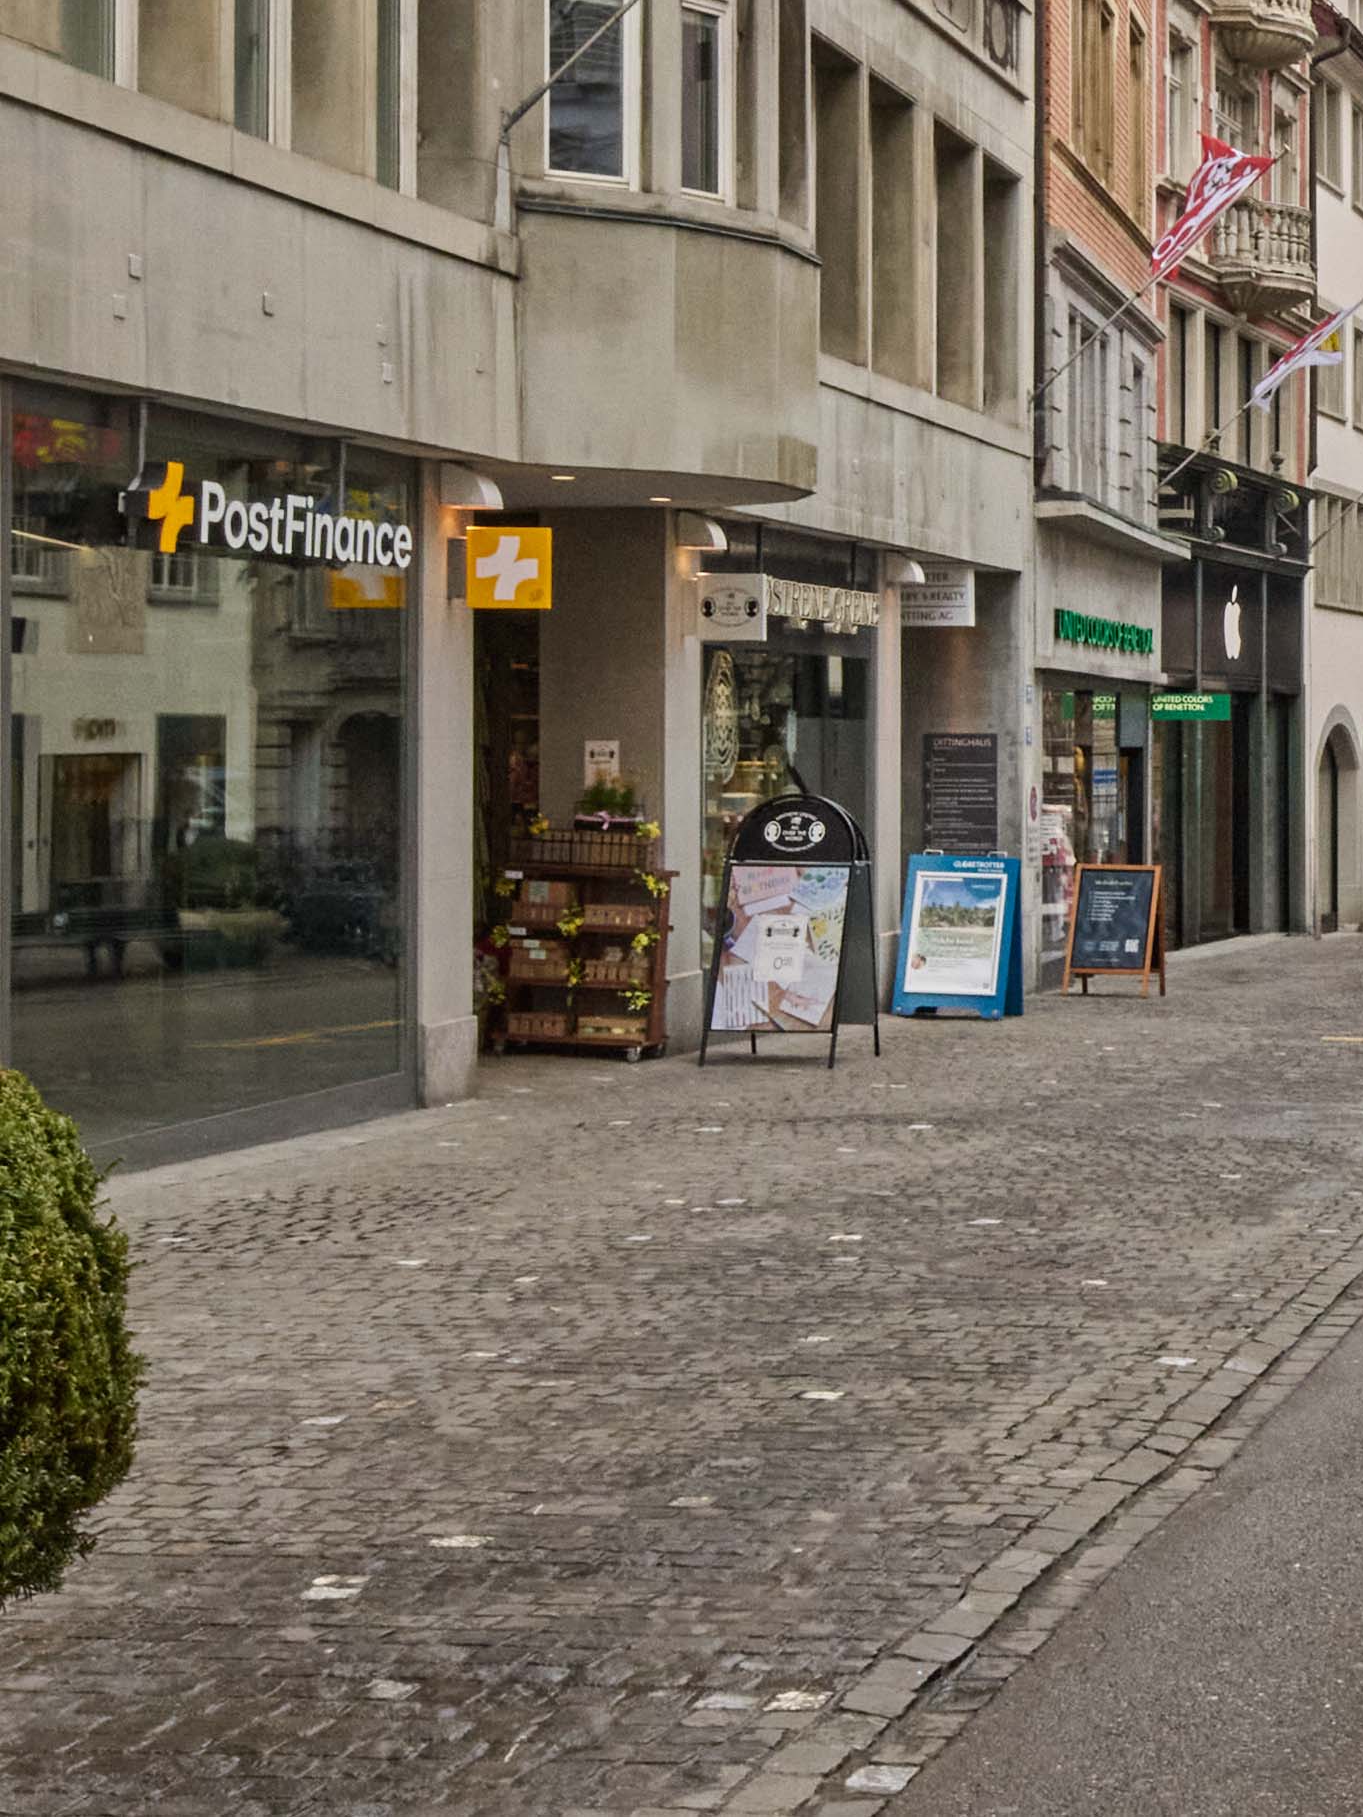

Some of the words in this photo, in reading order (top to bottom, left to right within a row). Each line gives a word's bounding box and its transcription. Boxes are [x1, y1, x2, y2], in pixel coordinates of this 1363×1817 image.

[200, 479, 414, 568] PostFinance
[1153, 695, 1181, 704] UNITED
[1182, 695, 1213, 704] COLORS
